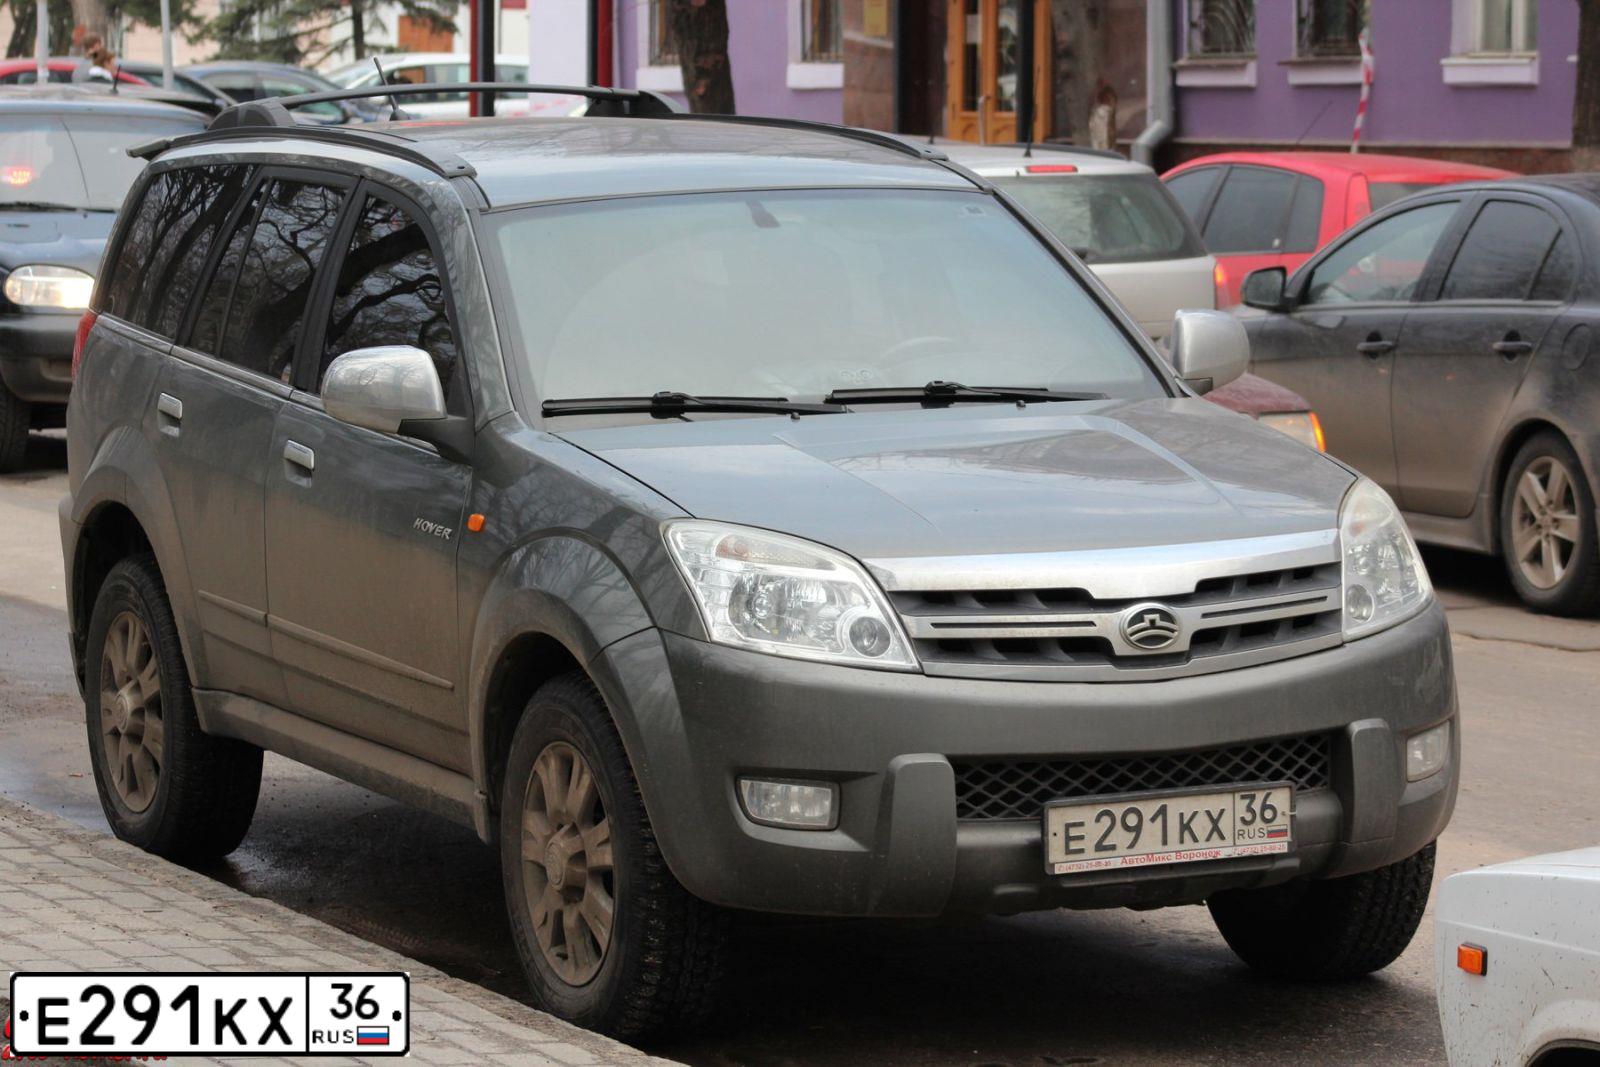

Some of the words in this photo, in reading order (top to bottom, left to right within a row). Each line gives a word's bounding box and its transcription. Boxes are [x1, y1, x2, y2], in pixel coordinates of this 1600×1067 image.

[413, 517, 452, 540] HOVER
[1240, 792, 1278, 825] 36
[1237, 828, 1265, 840] RUS
[1121, 853, 1172, 865] АвтоМикс
[1175, 850, 1221, 861] Воронеж
